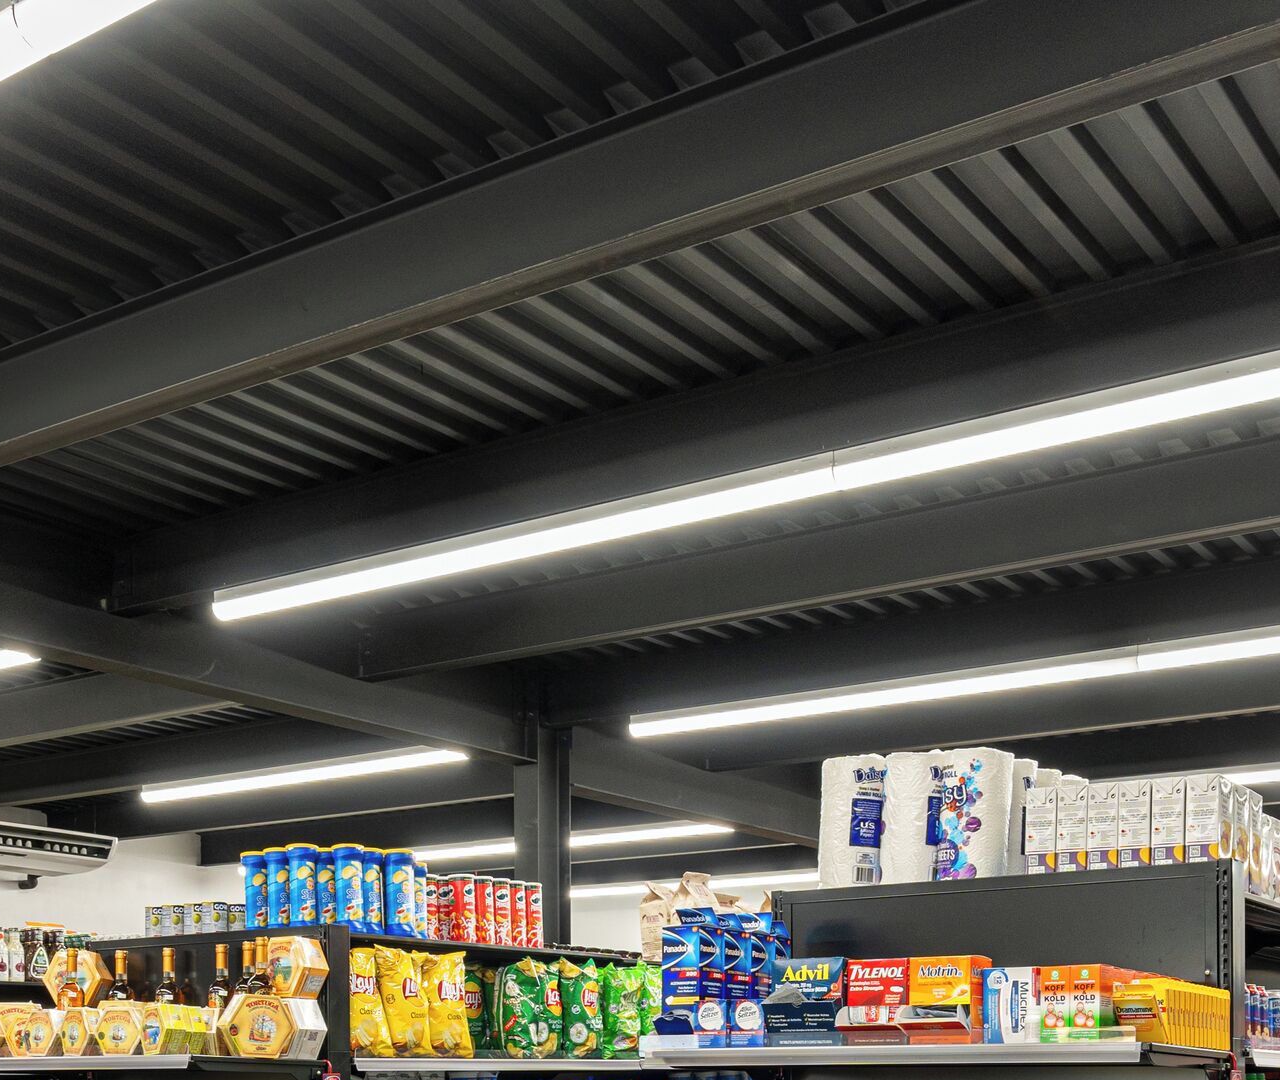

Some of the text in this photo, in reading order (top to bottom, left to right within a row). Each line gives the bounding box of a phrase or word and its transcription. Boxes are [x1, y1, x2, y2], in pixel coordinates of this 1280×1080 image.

[663, 945, 686, 953] Panadol
[781, 963, 829, 982] Advil
[849, 965, 904, 979] TYLENOL
[917, 964, 958, 977] Motrin
[1045, 984, 1065, 992] KOFF
[1074, 983, 1095, 991] KOFF
[1044, 994, 1066, 1002] KOLD
[1073, 994, 1095, 1002] KOLD
[245, 998, 281, 1011] TORTUGA
[1018, 981, 1028, 1032] Mucinex
[700, 1011, 719, 1019] Seltzer
[104, 1016, 131, 1024] TORTUGA
